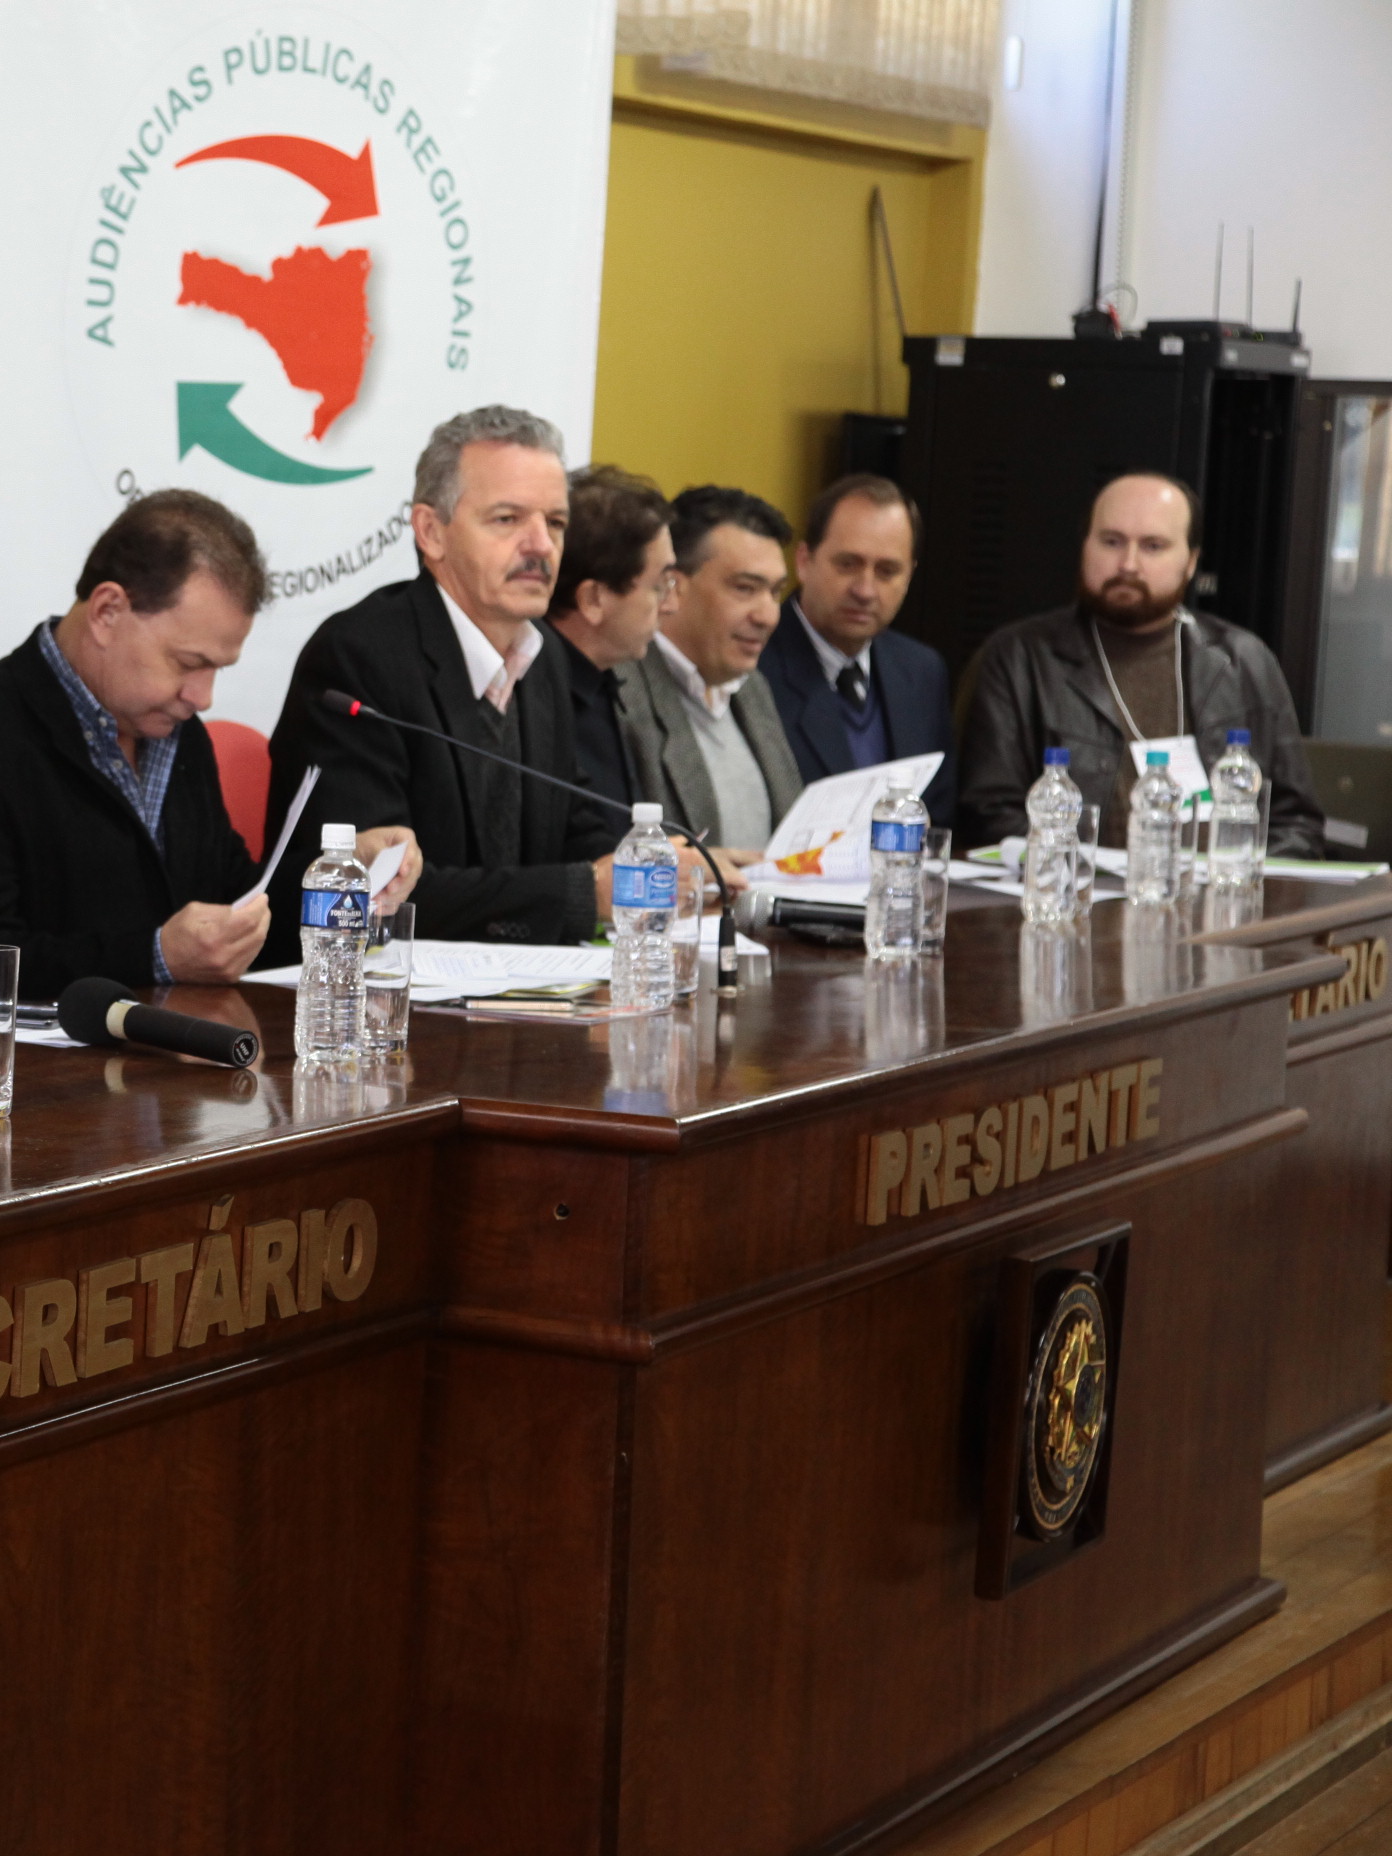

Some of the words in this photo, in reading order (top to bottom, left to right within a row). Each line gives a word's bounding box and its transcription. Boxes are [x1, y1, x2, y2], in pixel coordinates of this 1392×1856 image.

[86, 65, 213, 348] AUDIÊNCIAS
[224, 30, 395, 116] PÚBLICAS
[396, 109, 477, 372] REGIONAIS
[263, 499, 412, 602] EGIONALIZADO
[860, 1059, 1162, 1225] PRESIDENTE
